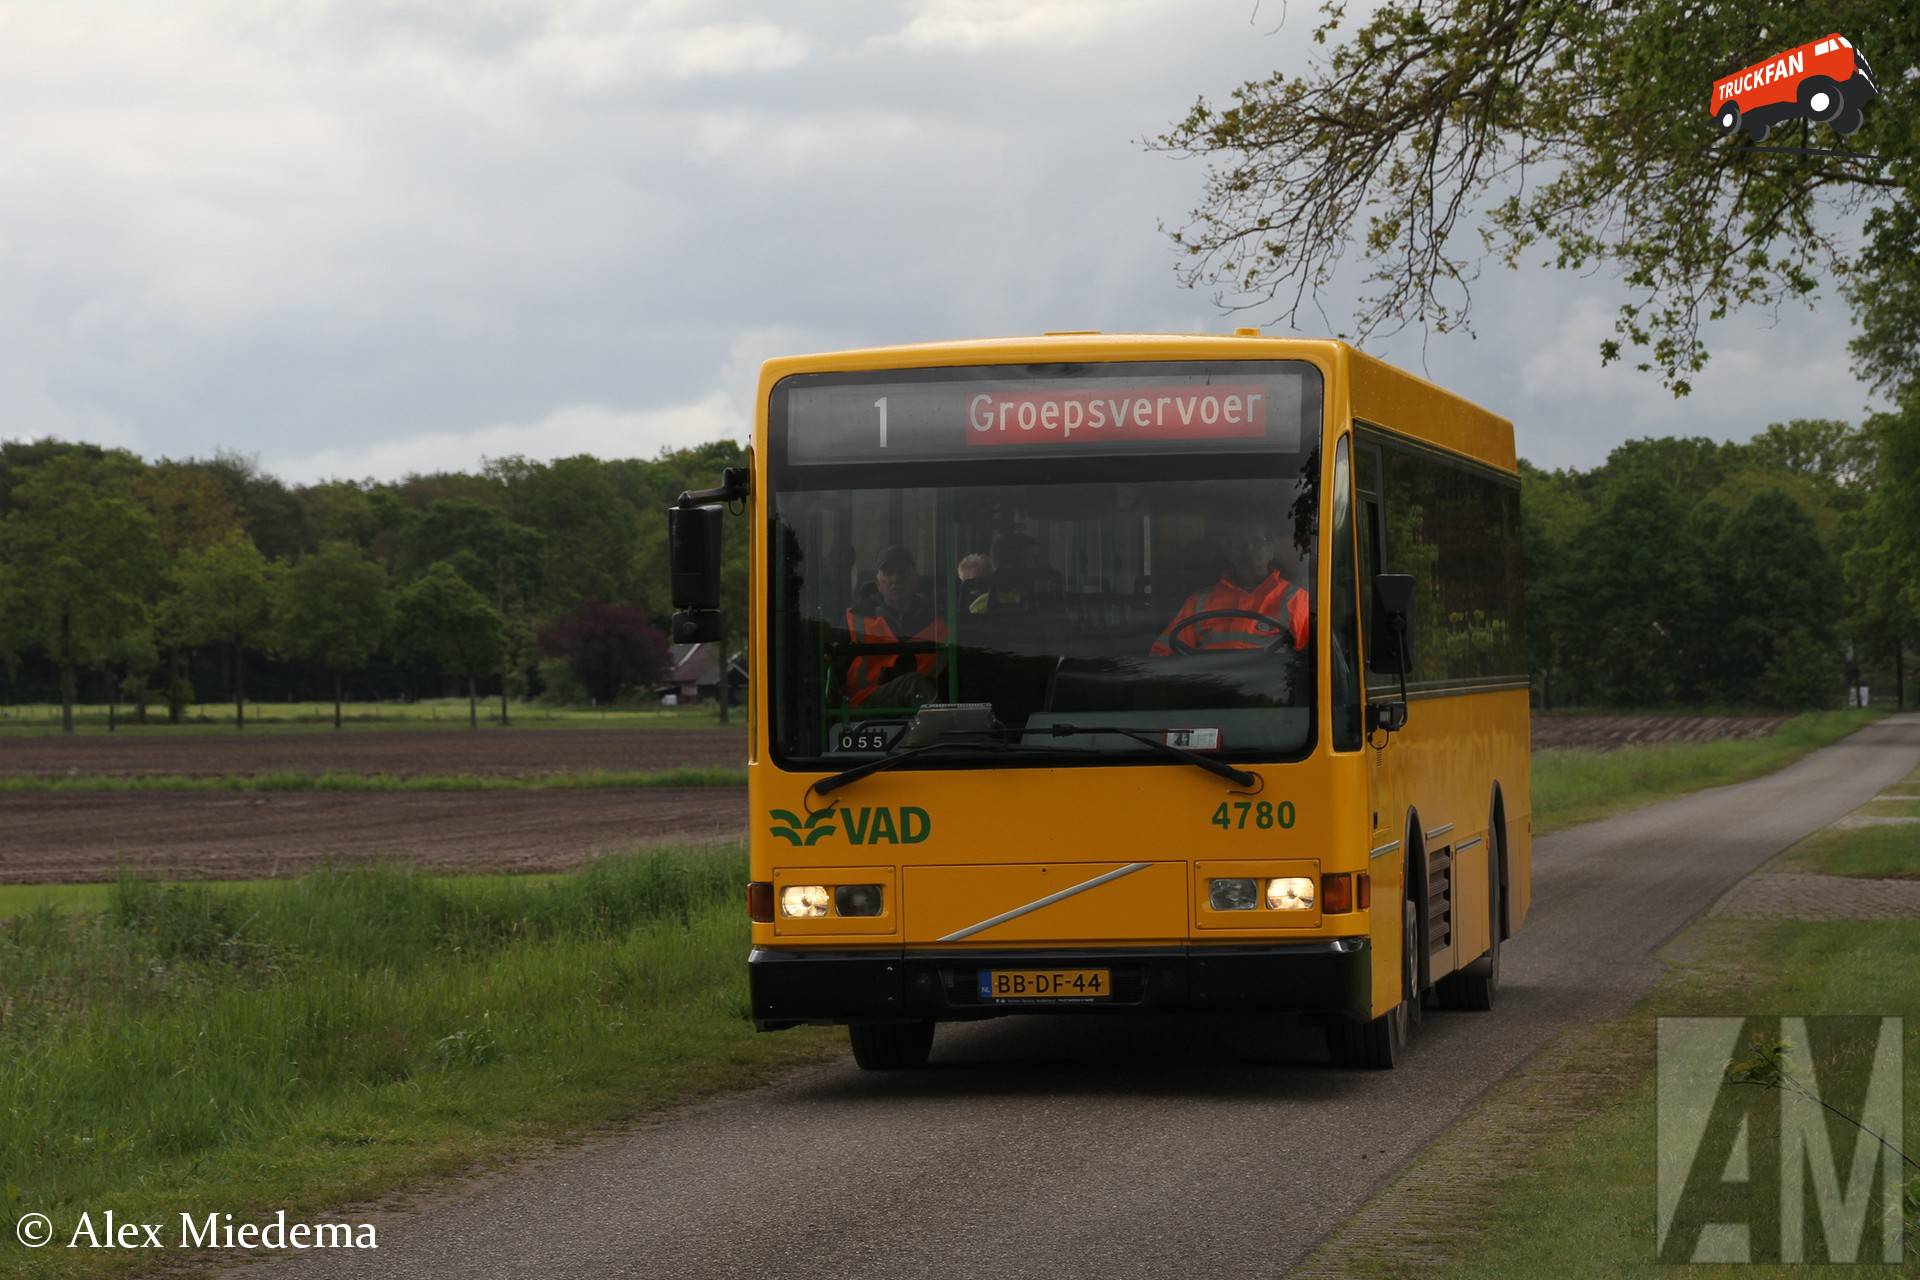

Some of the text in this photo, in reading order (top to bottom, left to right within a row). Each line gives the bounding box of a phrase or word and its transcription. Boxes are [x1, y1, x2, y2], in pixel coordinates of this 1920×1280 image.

[874, 393, 1262, 448] 1 Groepsvervoer
[840, 806, 931, 845] VAD
[1212, 801, 1296, 829] 4780
[998, 973, 1101, 993] BB-DF-44
